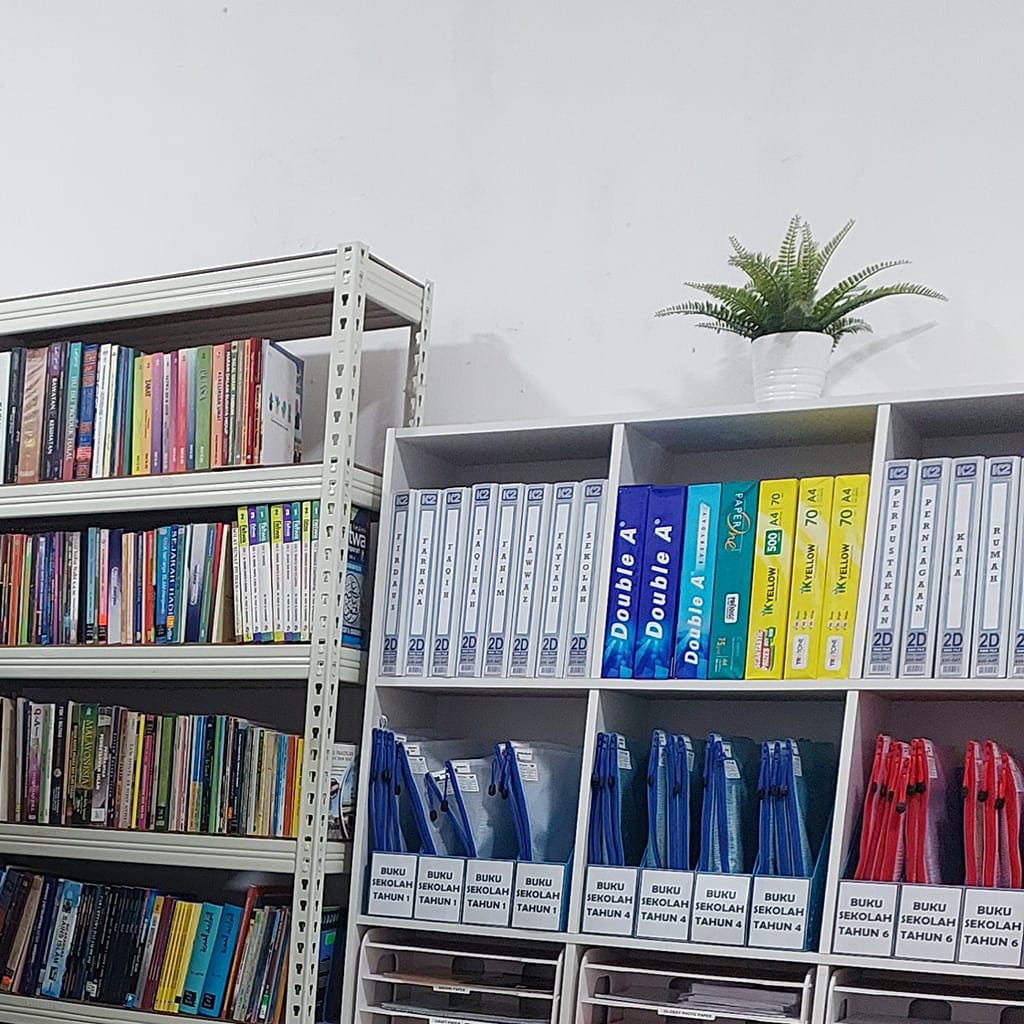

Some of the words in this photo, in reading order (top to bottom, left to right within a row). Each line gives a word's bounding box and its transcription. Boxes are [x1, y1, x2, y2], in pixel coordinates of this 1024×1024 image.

[771, 492, 781, 506] 70
[806, 488, 817, 503] A4
[841, 488, 852, 503] A4
[770, 511, 779, 526] A4
[805, 509, 819, 527] 70
[840, 509, 854, 527] 70
[619, 528, 637, 545] A
[654, 525, 673, 543] A
[767, 532, 778, 552] 500
[880, 488, 901, 624] PERPUSTAKAAN
[915, 498, 933, 612] PERNIAGAAN
[953, 532, 966, 577] KAFA
[989, 526, 1001, 583] RUMAH
[469, 528, 483, 608] FAQIHAH
[496, 540, 509, 597] FAHIM
[522, 534, 535, 603] FAWWAZ
[551, 532, 564, 603] FAYYADH
[579, 531, 592, 603] SEKOLAH
[805, 543, 816, 581] YELLOW
[839, 543, 851, 581] YELLOW
[416, 538, 429, 606] FARHANA
[443, 543, 454, 599] FAQIH
[690, 575, 705, 590] A
[765, 567, 777, 603] YELLOW
[610, 553, 636, 640] Double
[645, 551, 670, 640] Double
[684, 596, 704, 665] Double
[384, 638, 397, 651] 2D
[409, 638, 425, 651] 2D
[435, 638, 450, 651] 2D
[461, 635, 477, 648] 2D
[488, 637, 504, 650] 2D
[514, 638, 529, 651] 2D
[542, 637, 558, 651] 2D
[571, 637, 588, 650] 2D
[872, 632, 893, 647] 2D
[907, 632, 927, 647] 2D
[943, 632, 963, 647] 2D
[979, 632, 1000, 648] 2D
[380, 866, 406, 877] BUKU
[427, 870, 453, 880] BUKU
[475, 873, 502, 883] BUKU
[372, 878, 413, 889] SEKOLAH
[418, 882, 461, 893] SEKOLAH
[525, 877, 552, 887] BUKU
[596, 881, 625, 891] BUKU
[466, 885, 510, 896] SEKOLAH
[516, 889, 561, 900] SEKOLAH
[651, 884, 681, 895] BUKU
[706, 889, 736, 900] BUKU
[373, 891, 406, 902] TAHUN
[419, 896, 452, 906] TAHUN
[587, 894, 633, 904] SEKOLAH
[641, 897, 689, 909] SEKOLAH
[764, 892, 796, 903] BUKU
[467, 899, 501, 910] TAHUN
[517, 903, 551, 914] TAHUN
[695, 902, 745, 913] SEKOLAH
[850, 898, 883, 909] BUKU
[912, 901, 947, 913] BUKU
[587, 908, 622, 918] TAHUN
[641, 911, 677, 923] TAHUN
[753, 905, 805, 917] SEKOLAH
[839, 911, 892, 923] SEKOLAH
[976, 905, 1012, 917] BUKU
[695, 917, 733, 928] TAHUN
[753, 920, 792, 931] TAHUN
[900, 914, 956, 927] SEKOLAH
[964, 918, 1022, 931] SEKOLAH
[838, 926, 880, 937] TAHUN
[900, 930, 943, 942] TAHUN
[964, 935, 1008, 947] TAHUN
